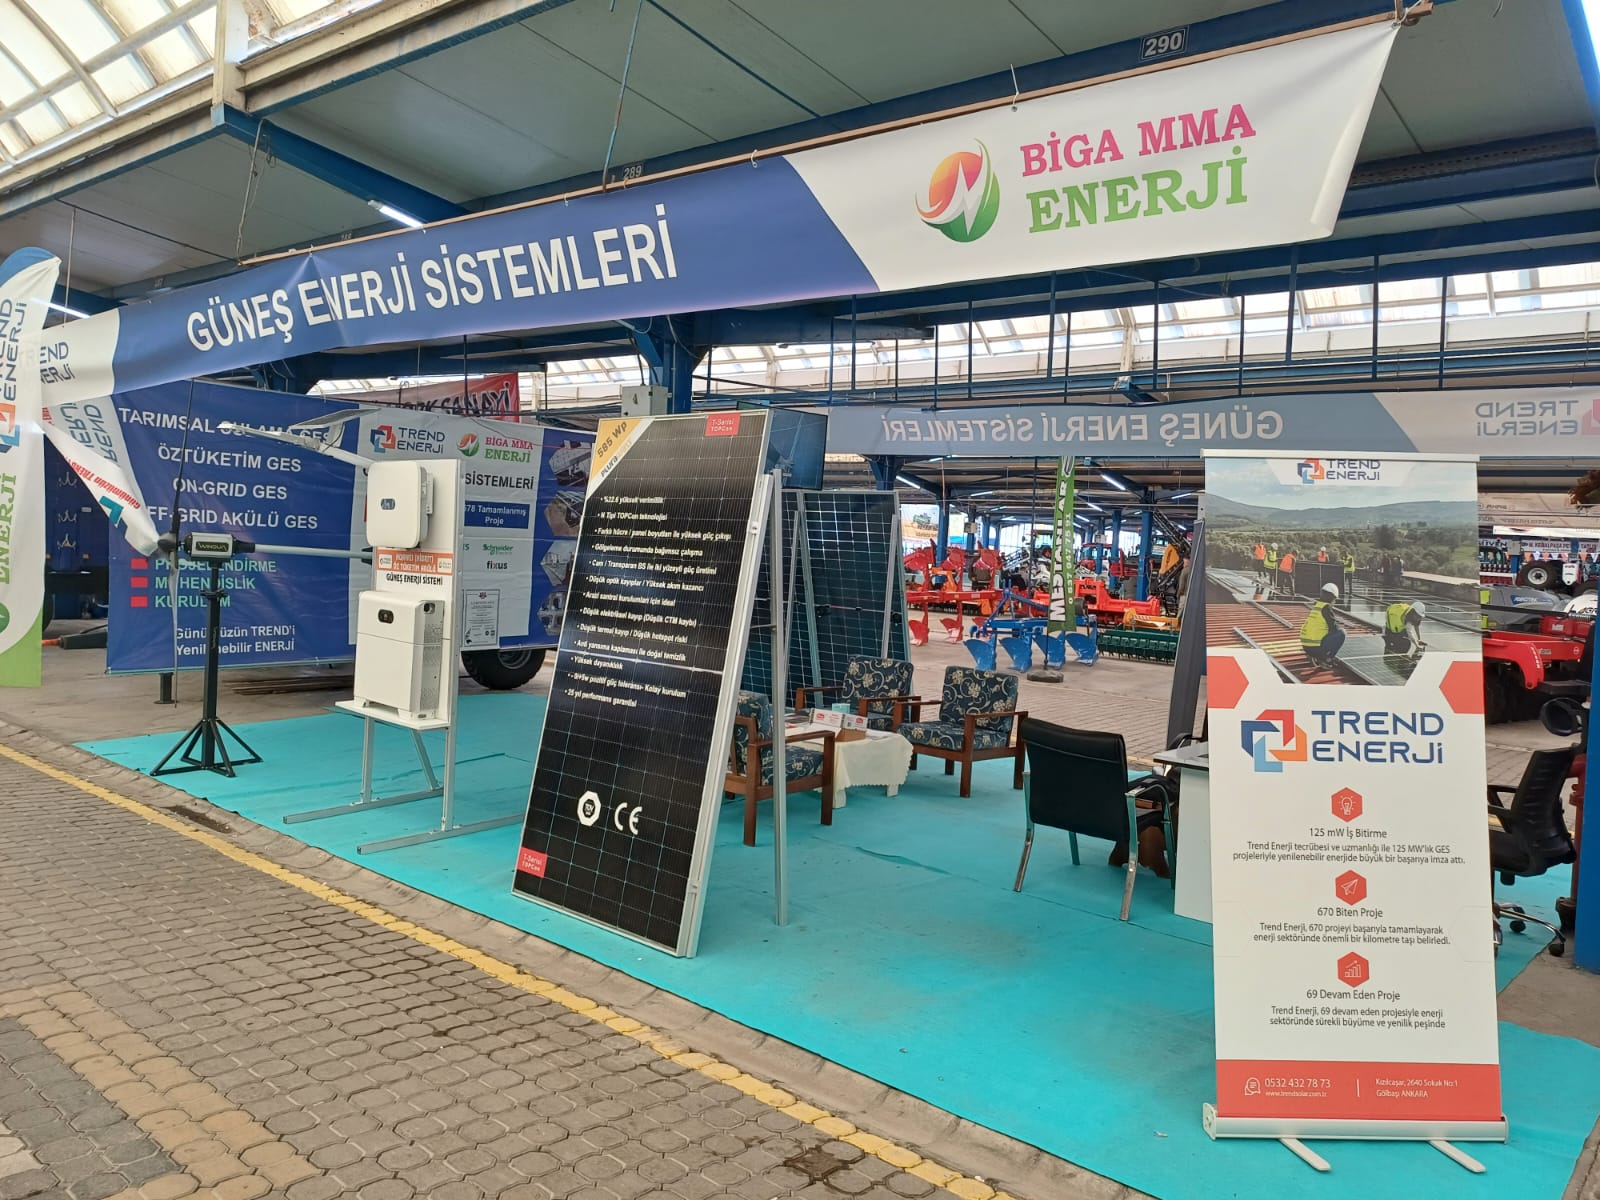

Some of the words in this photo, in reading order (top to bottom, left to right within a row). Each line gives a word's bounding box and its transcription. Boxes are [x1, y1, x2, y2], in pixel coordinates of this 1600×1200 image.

[1144, 32, 1182, 57] 290
[1020, 131, 1124, 177] BİGA
[1138, 104, 1256, 156] MMA
[624, 166, 642, 179] 289
[1027, 146, 1248, 234] ENERJİ
[186, 288, 294, 351] GÜNEŞ
[298, 252, 416, 326] ENERJİ
[420, 204, 678, 309] SİSTEMLERİ
[118, 408, 215, 434] TARIMSAL
[398, 426, 446, 442] TREND
[597, 438, 613, 458] 585
[612, 421, 628, 439] Wp
[512, 439, 534, 450] MMA
[158, 442, 262, 468] ÖZTÜKETİM
[266, 456, 301, 472] GES
[1326, 458, 1381, 469] TREND
[465, 470, 534, 490] SİSTEMLERİ
[172, 478, 246, 498] ON-GRID
[252, 485, 288, 500] GES
[478, 504, 526, 517] Tamamlanmış
[148, 506, 218, 524] FF-GRID
[222, 510, 280, 528] AKÜLÜ
[284, 515, 318, 530] GES
[484, 516, 504, 526] Proje
[486, 560, 508, 570] fixus
[155, 575, 256, 590] MHENİSLİK
[155, 596, 231, 608] KURULM
[176, 626, 248, 640] Günüüzün
[250, 625, 296, 637] TREND'i
[176, 642, 252, 656] Yenilnebilir
[255, 638, 294, 652] ENERJİ
[1312, 710, 1444, 736] TREND
[614, 802, 642, 835] CE
[1309, 828, 1325, 838] 125
[1327, 828, 1344, 838] mW
[1346, 826, 1353, 840] İş
[1356, 829, 1387, 838] Bitirme
[1248, 841, 1269, 850] Trend
[1271, 842, 1293, 852] Enerji
[1294, 842, 1329, 852] tecrübesi
[1342, 842, 1379, 854] uzmanlığı
[1382, 843, 1390, 852] ile
[1392, 844, 1406, 853] 125
[1435, 845, 1450, 854] GES
[1233, 852, 1276, 862] projeleriyle
[1278, 852, 1324, 863] yenilenebilir
[1326, 853, 1357, 863] enerjide
[1360, 853, 1383, 864] büyük
[1385, 854, 1396, 863] bir
[1397, 854, 1429, 865] başarıya
[1430, 856, 1448, 864] imza
[1317, 908, 1334, 917] 670
[1336, 908, 1358, 917] Biten
[1360, 908, 1383, 919] Proje
[1260, 923, 1282, 931] Trend
[1284, 923, 1307, 934] Enerji,
[1309, 924, 1323, 932] 670
[1325, 924, 1351, 935] projeyi
[1353, 924, 1387, 935] başarıyla
[1389, 925, 1443, 936] tamamlayarak
[1254, 934, 1276, 944] enerji
[1277, 934, 1320, 943] sektöründe
[1322, 935, 1349, 943] önemli
[1351, 935, 1361, 943] bir
[1363, 935, 1400, 944] kilometre
[1401, 936, 1414, 945] taşı
[1416, 936, 1450, 945] belirledi.
[1306, 990, 1318, 999] 69
[1320, 990, 1350, 999] Devam
[1353, 990, 1375, 1000] Eden
[1377, 991, 1400, 1002] Proje
[1272, 1006, 1294, 1015] Trend
[1295, 1006, 1318, 1017] Enerji,
[1320, 1007, 1330, 1016] 69
[1332, 1007, 1358, 1016] devam
[1360, 1008, 1380, 1016] eden
[1382, 1008, 1419, 1019] projesiyle
[1421, 1009, 1443, 1019] enerji
[1270, 1017, 1314, 1026] sektöründe
[1316, 1018, 1341, 1027] sürekli
[1342, 1018, 1375, 1029] büyüme
[1387, 1019, 1412, 1030] yenilik
[1414, 1020, 1446, 1030] peşinde
[1265, 1078, 1286, 1088] 0532
[1288, 1079, 1304, 1088] 432
[1306, 1079, 1318, 1088] 78
[1320, 1079, 1331, 1088] 73
[1407, 1079, 1422, 1087] 2640
[1401, 1090, 1428, 1098] ANKARA
